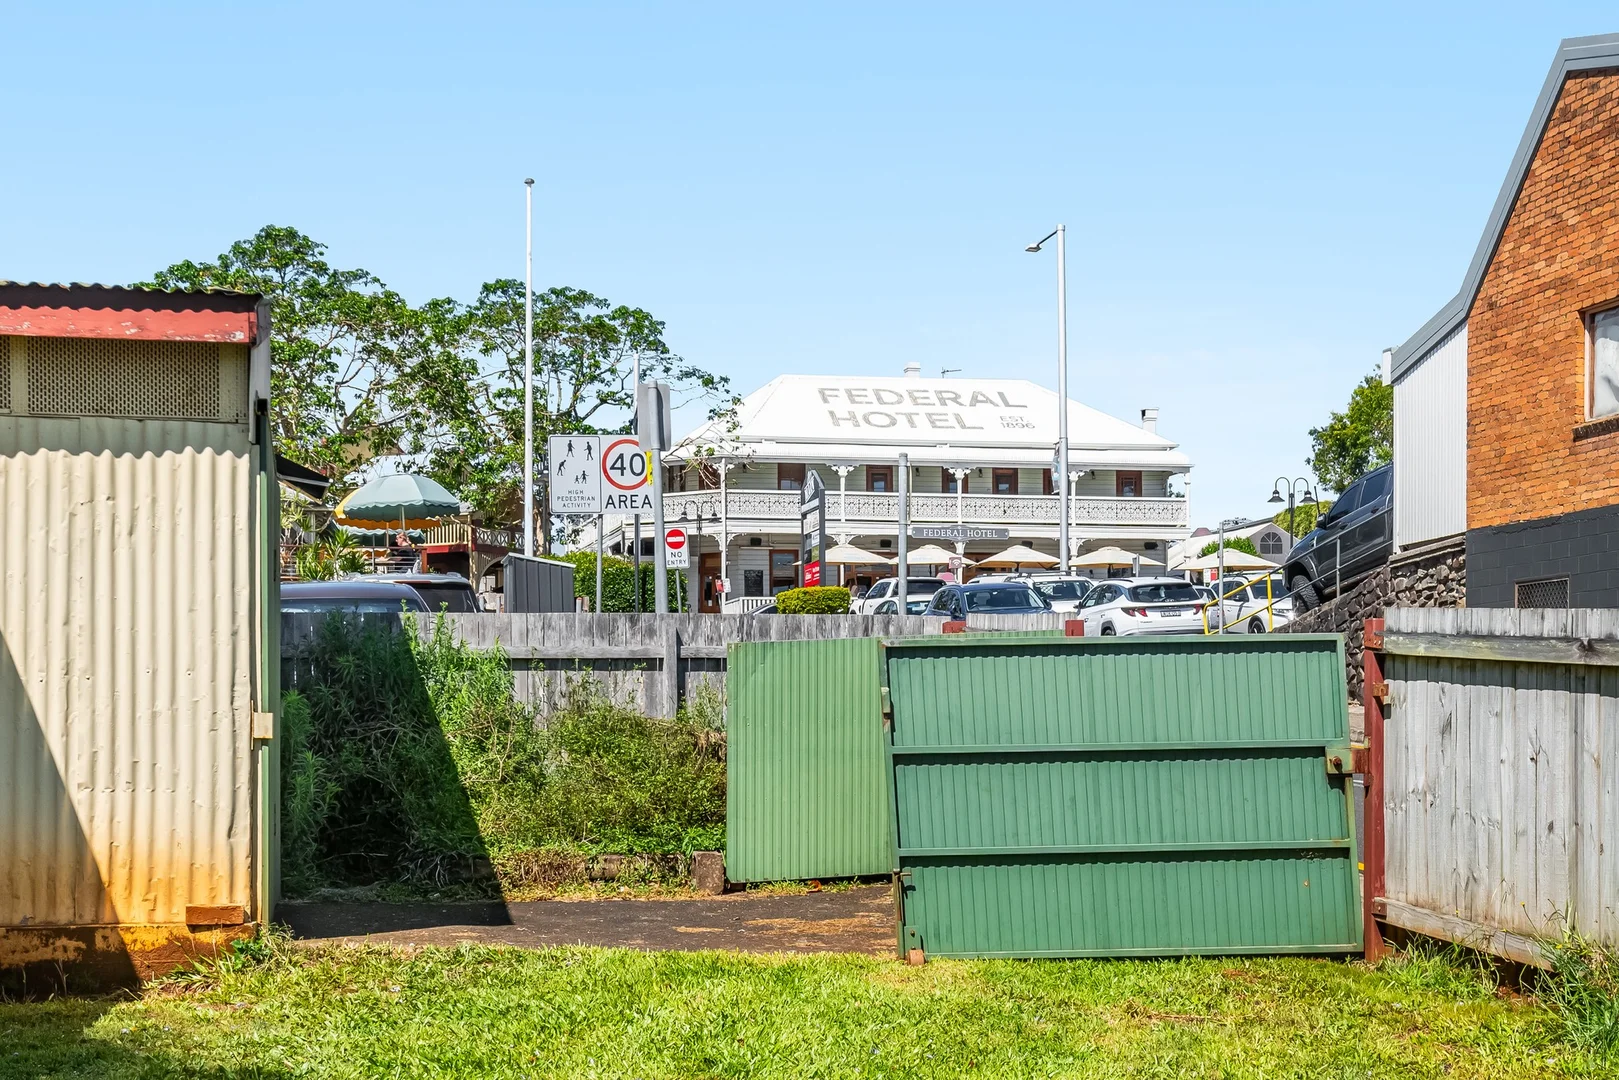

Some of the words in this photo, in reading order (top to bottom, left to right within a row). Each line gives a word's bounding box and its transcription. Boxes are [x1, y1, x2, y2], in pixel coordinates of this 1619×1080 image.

[818, 387, 1028, 409] FEDERAL
[828, 410, 984, 430] HOTEL
[609, 453, 646, 477] 40
[605, 494, 653, 509] AREA
[923, 528, 964, 538] FEDERAL
[967, 529, 998, 538] HOTEL
[670, 551, 683, 559] NO
